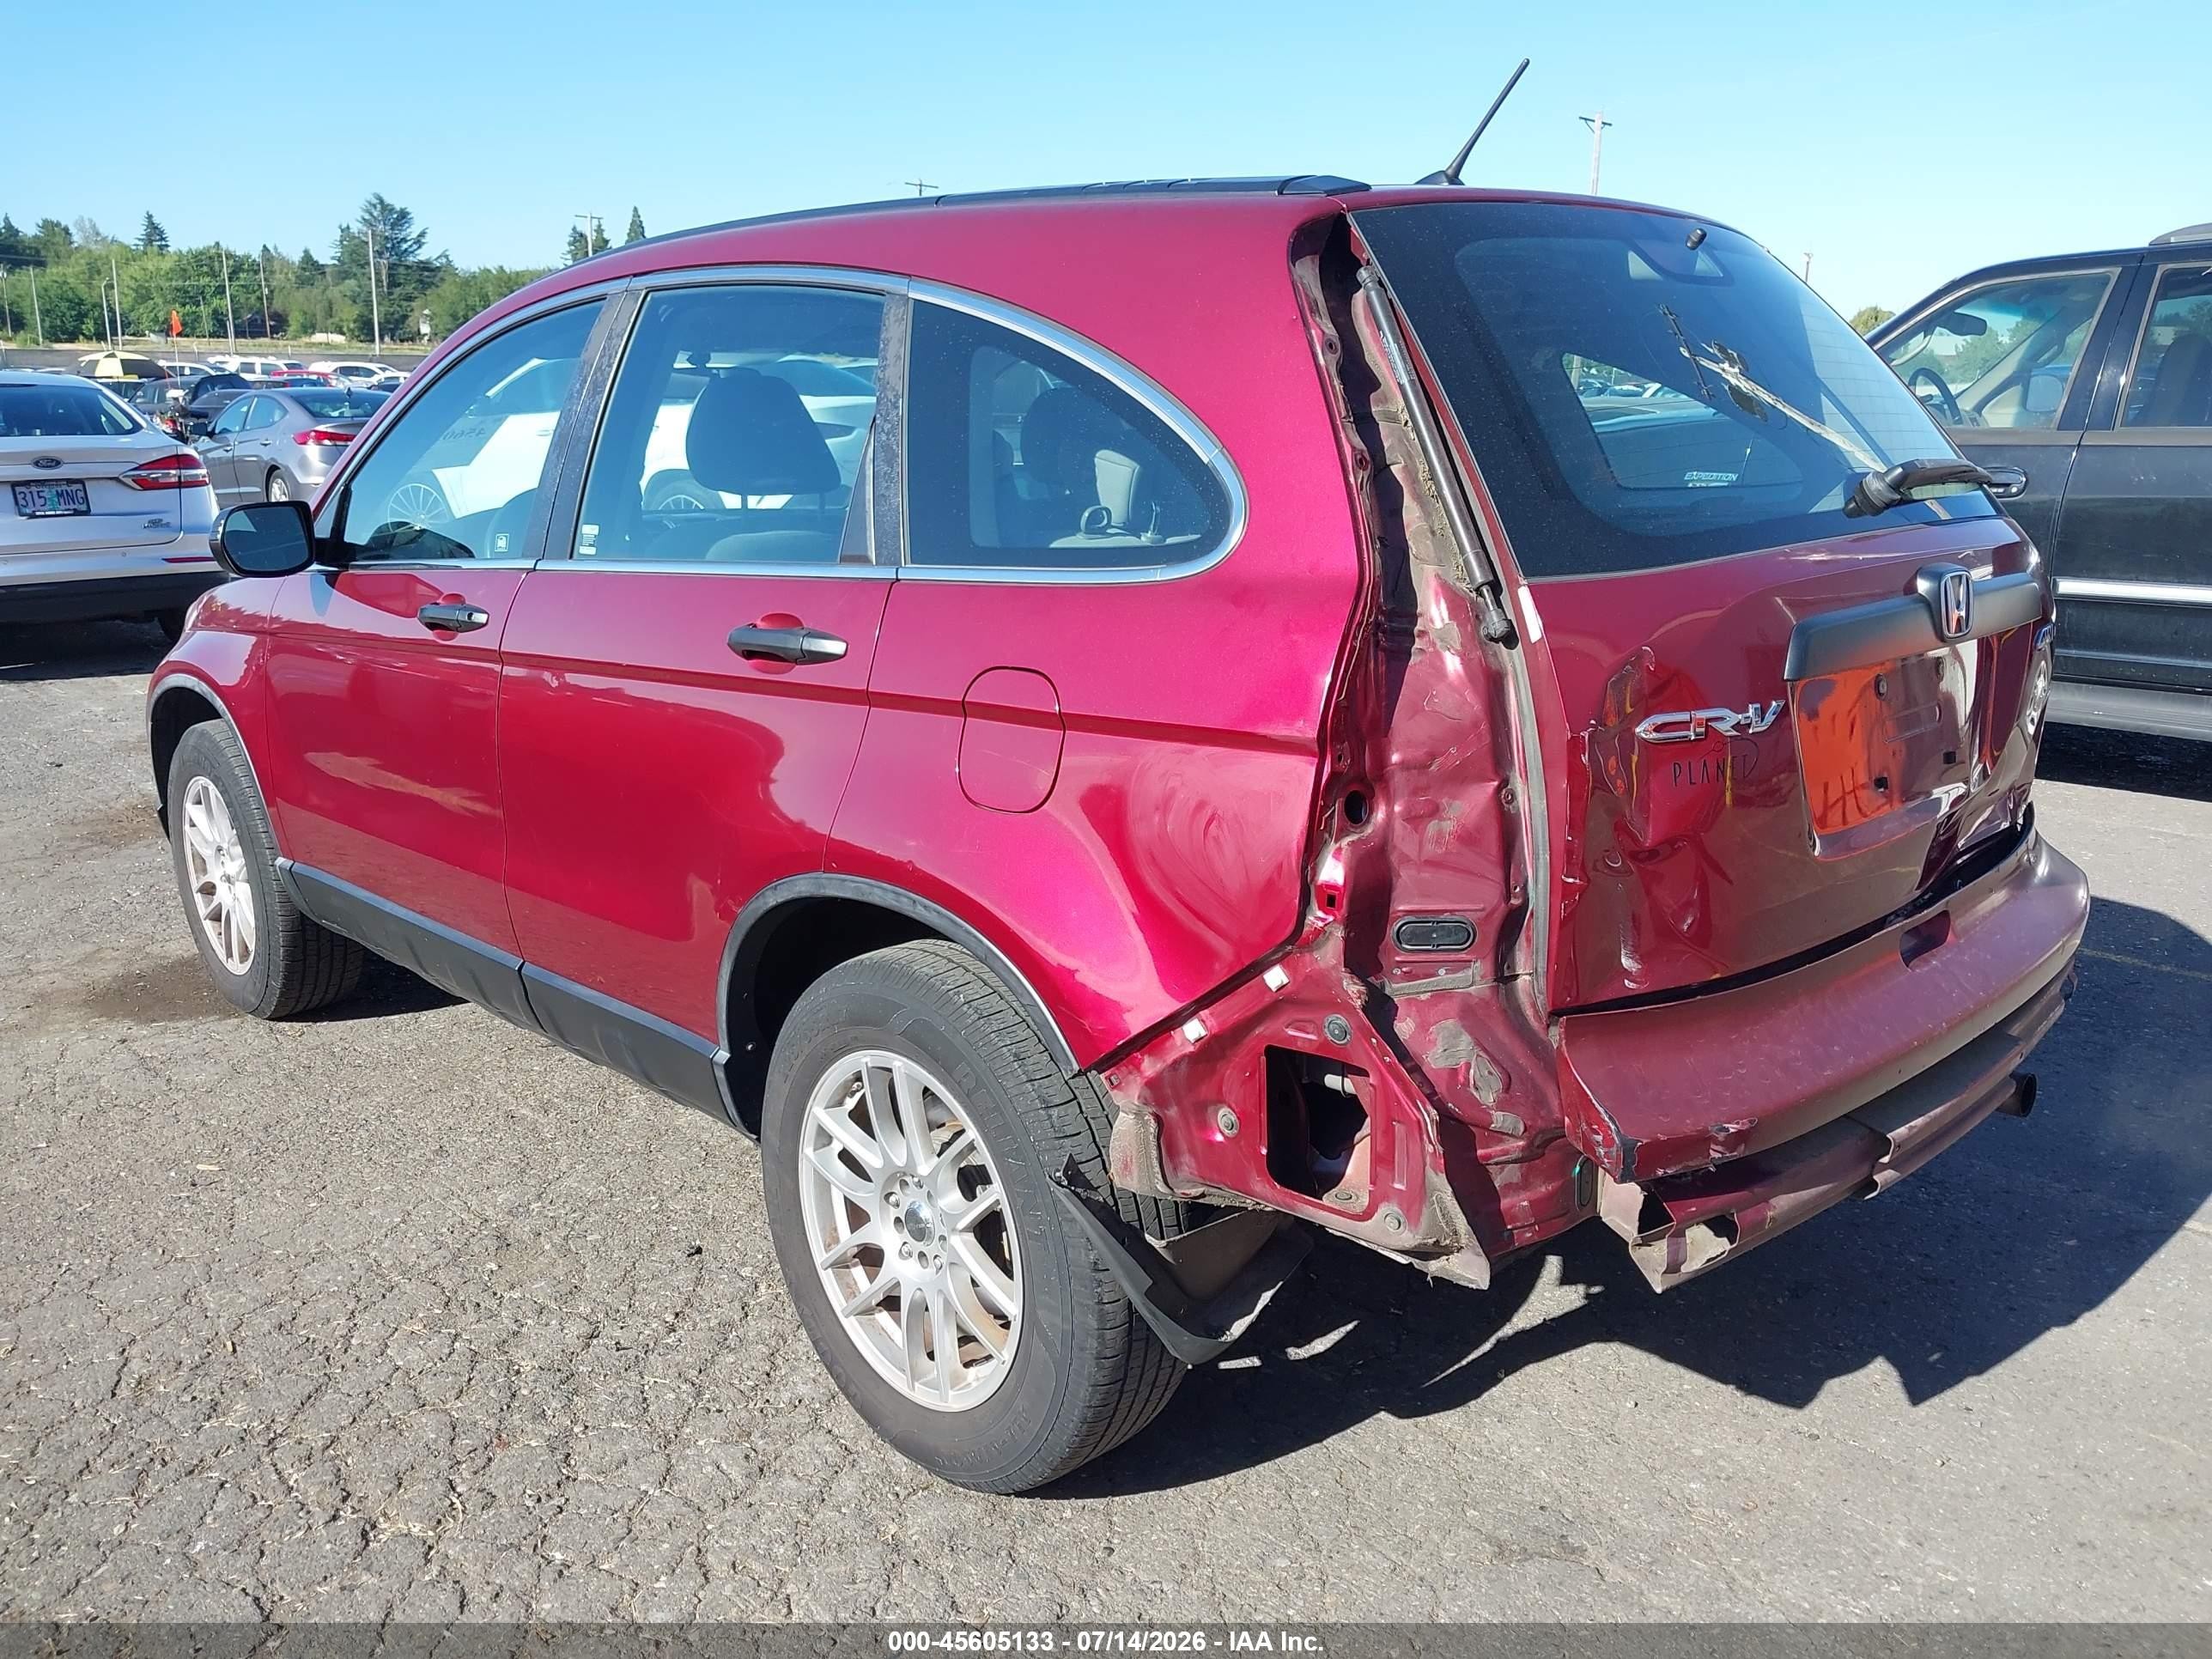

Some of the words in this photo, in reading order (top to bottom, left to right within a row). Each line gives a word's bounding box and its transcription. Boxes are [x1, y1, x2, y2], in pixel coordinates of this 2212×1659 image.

[1684, 471, 1739, 481] EXPEDITION
[17, 489, 47, 508] 315
[56, 489, 86, 506] MNG
[1635, 700, 1786, 744] CR-V
